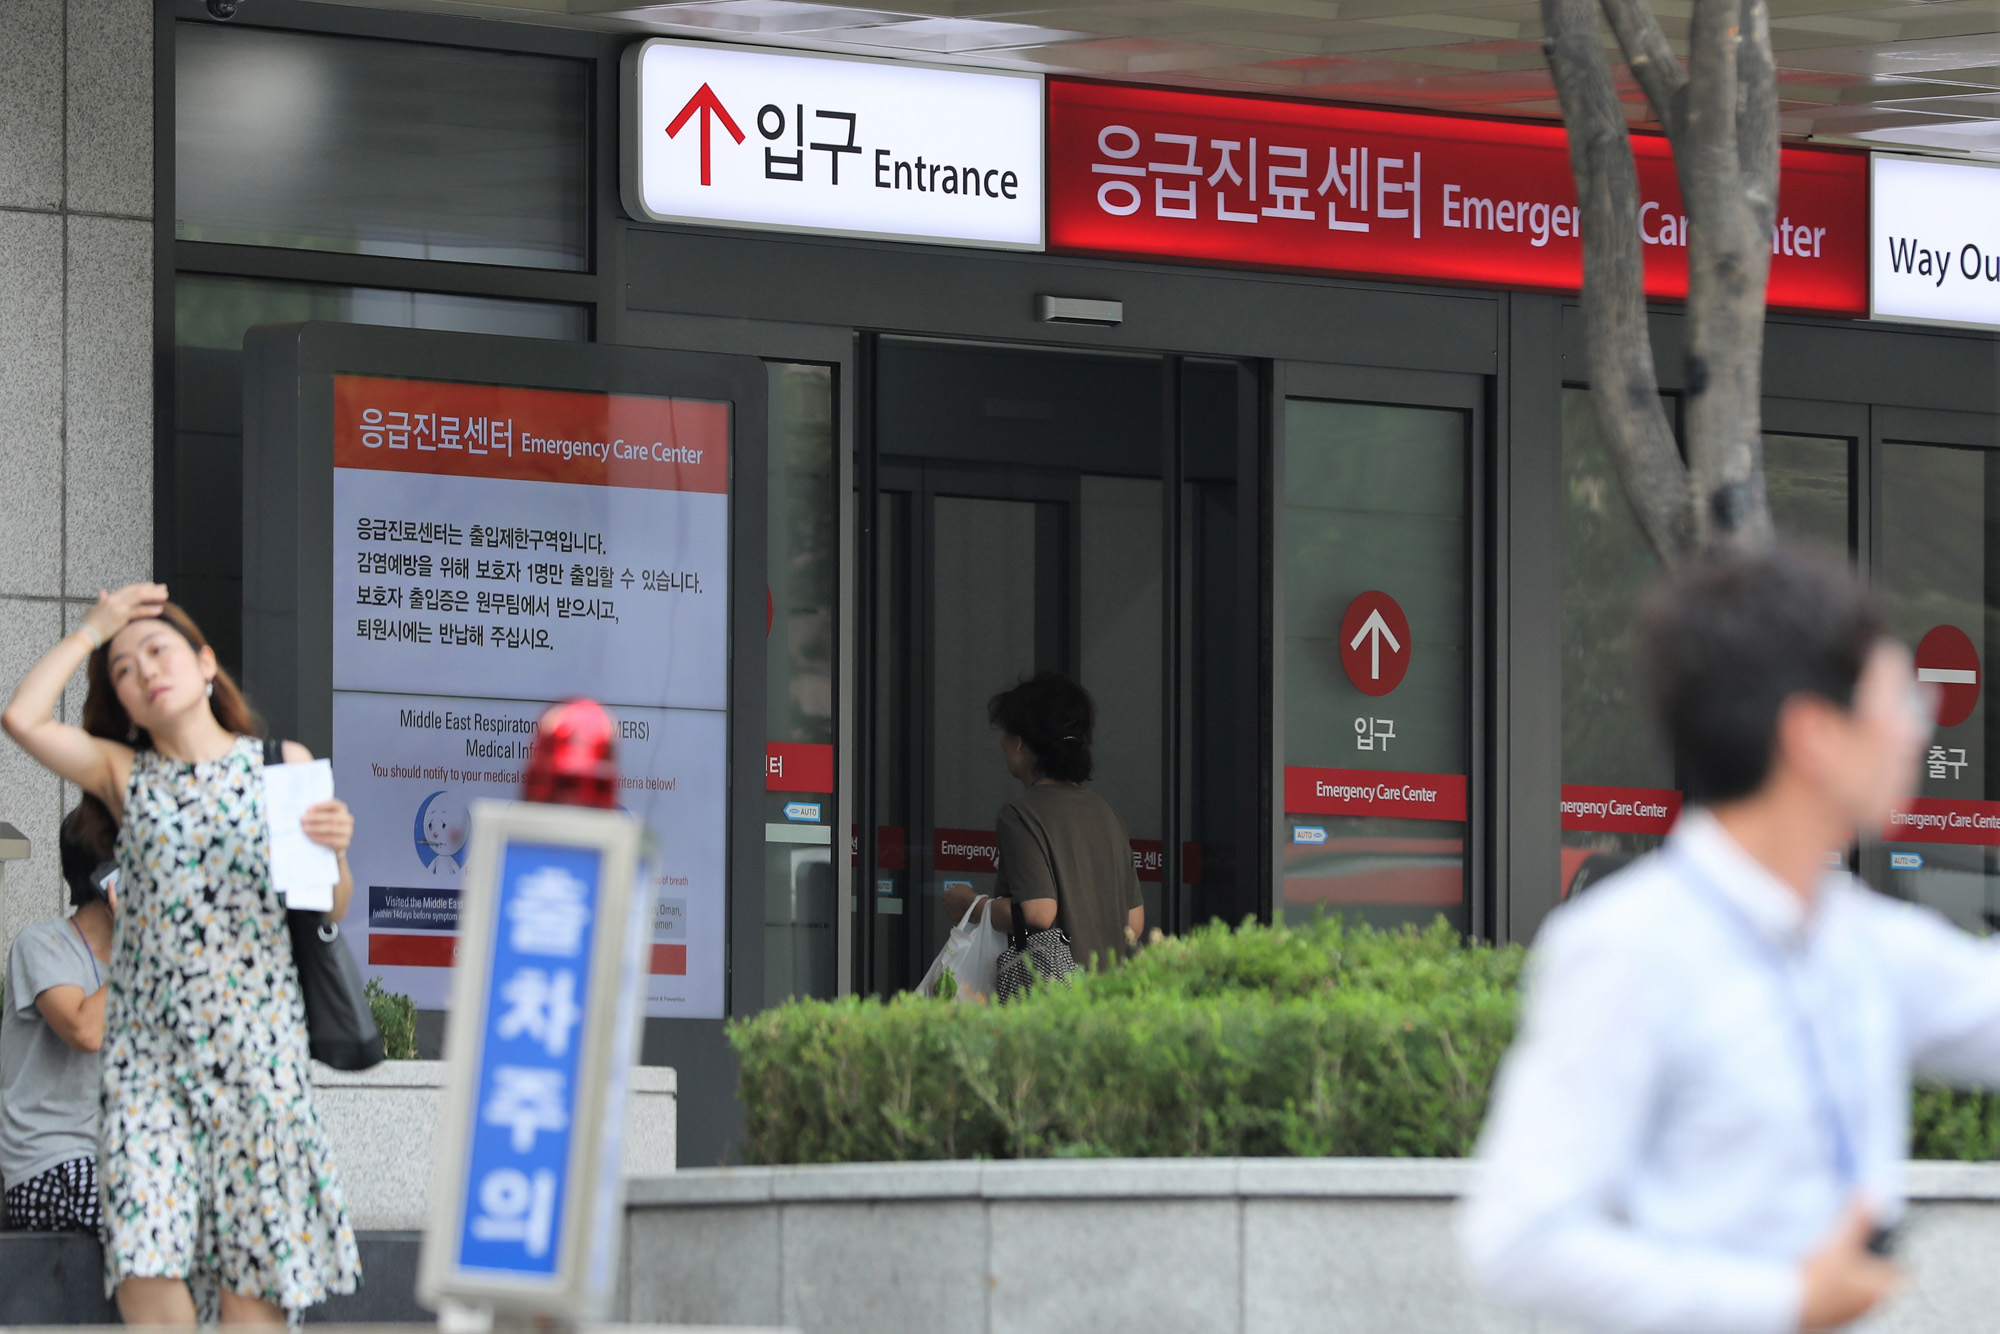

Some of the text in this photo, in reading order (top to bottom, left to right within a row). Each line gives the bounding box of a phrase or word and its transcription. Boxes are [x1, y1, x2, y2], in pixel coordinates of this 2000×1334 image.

[757, 103, 1018, 200] 입구 Entrance
[1091, 124, 1826, 258] 응급진료센터 Emerge Car ter
[1888, 236, 2000, 288] Way Ou
[360, 407, 703, 464] 응급진료센터 Emergency Care Center
[357, 517, 607, 555] 응급진료센터는 출입제한구역입니다.
[357, 551, 703, 594] 감염예방을 위해 보호자 1명만 출입할 수 있습니다.
[357, 585, 619, 625] 보호자 출입증은 원무팀에서 받으시고,
[357, 618, 554, 650] 퇴원시에는 반납해 주십시오.
[400, 709, 442, 730] Middle
[446, 711, 471, 731] East
[1354, 717, 1396, 751] 입구
[466, 738, 514, 760] Medical
[1927, 745, 1968, 780] 출구
[372, 763, 388, 778] You
[391, 764, 421, 780] should
[424, 766, 449, 783] notify
[451, 768, 460, 781] to
[461, 770, 482, 785] your
[484, 769, 520, 784] medical
[615, 776, 676, 791] riteria below!
[1316, 781, 1437, 803] Emergency Care Center
[801, 808, 817, 817] AUTO
[1561, 799, 1667, 819] mergency Care Center
[1890, 808, 2000, 831] Emergency Care Cente
[1296, 831, 1313, 839] AUTO
[941, 840, 997, 861] Emergency
[1894, 857, 1908, 865] AUTO
[669, 876, 689, 886] breath
[385, 896, 409, 908] Visited
[410, 897, 422, 908] the
[423, 897, 447, 909] Middle
[660, 904, 682, 917] Oman,
